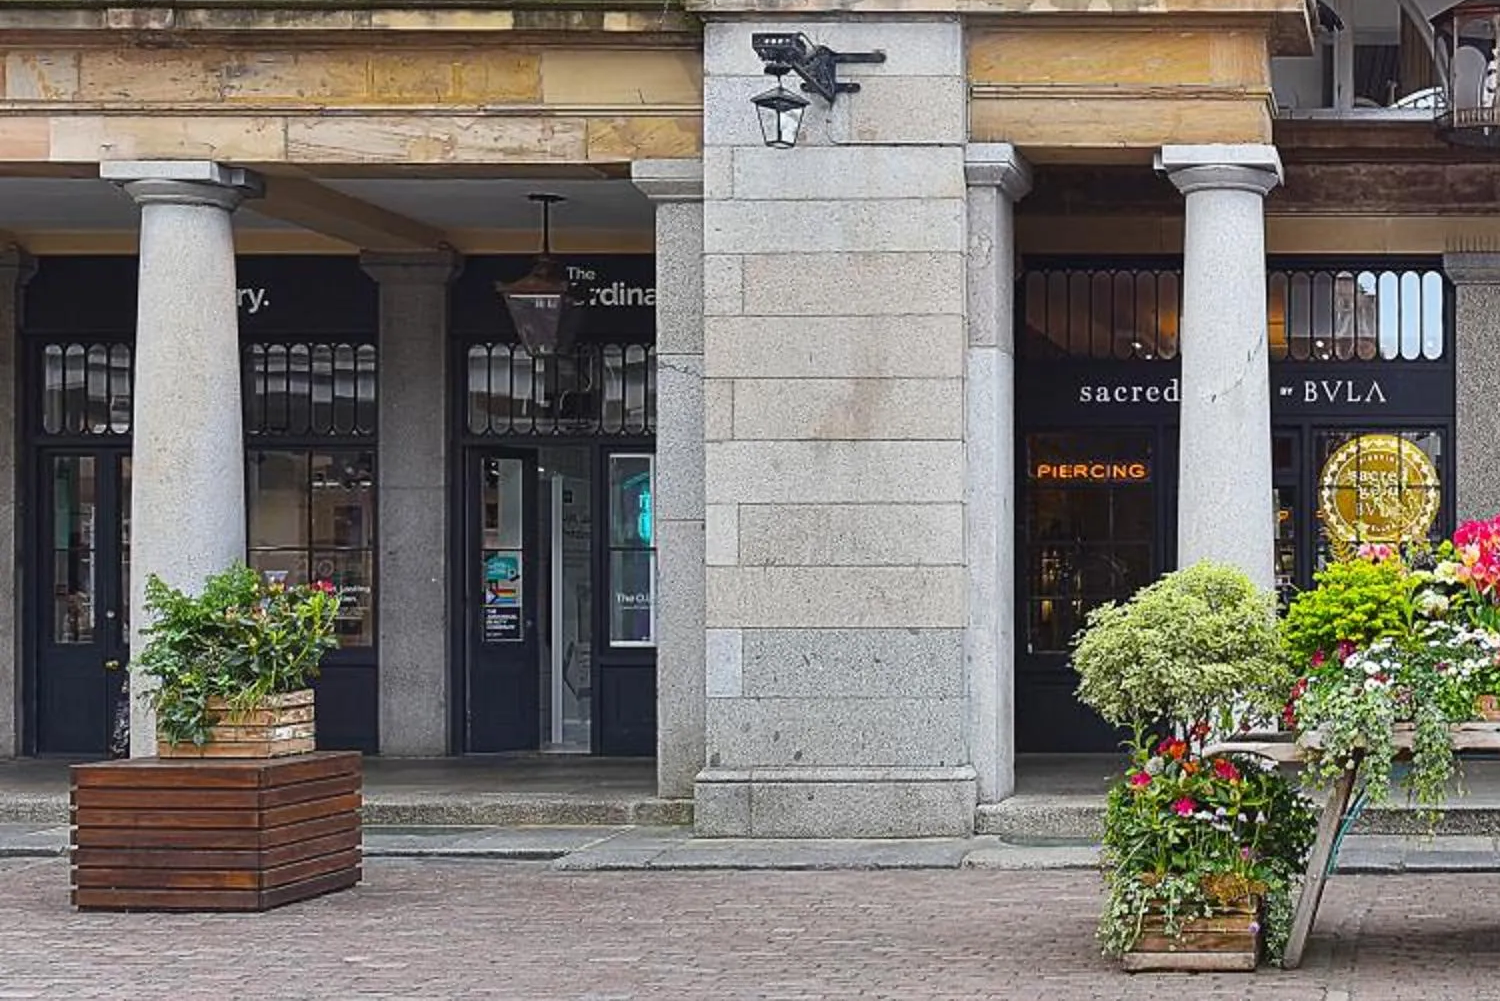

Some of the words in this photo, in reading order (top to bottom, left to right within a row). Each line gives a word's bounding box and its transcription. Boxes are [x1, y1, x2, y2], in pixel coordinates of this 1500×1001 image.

[566, 265, 597, 281] The
[237, 287, 270, 314] ry.
[570, 281, 656, 307] rdina
[1079, 378, 1181, 403] sacred
[1036, 463, 1147, 479] PIERCING
